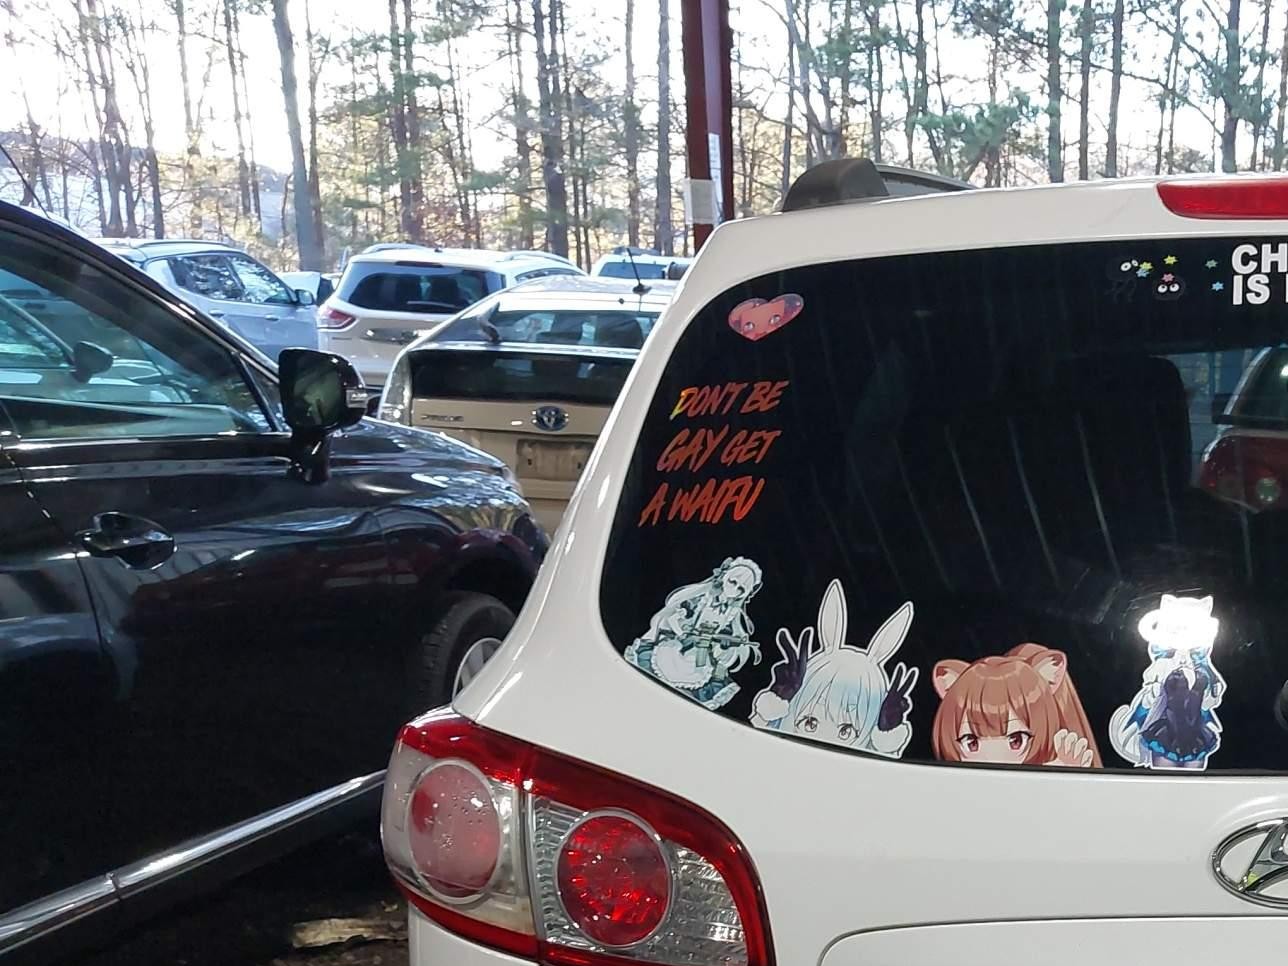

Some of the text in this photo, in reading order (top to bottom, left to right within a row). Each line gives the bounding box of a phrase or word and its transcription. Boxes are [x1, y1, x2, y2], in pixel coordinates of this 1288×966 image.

[1232, 273, 1270, 305] IS
[740, 380, 789, 414] BE
[656, 424, 783, 473] GAY GET
[638, 475, 766, 527] A WAIFU
